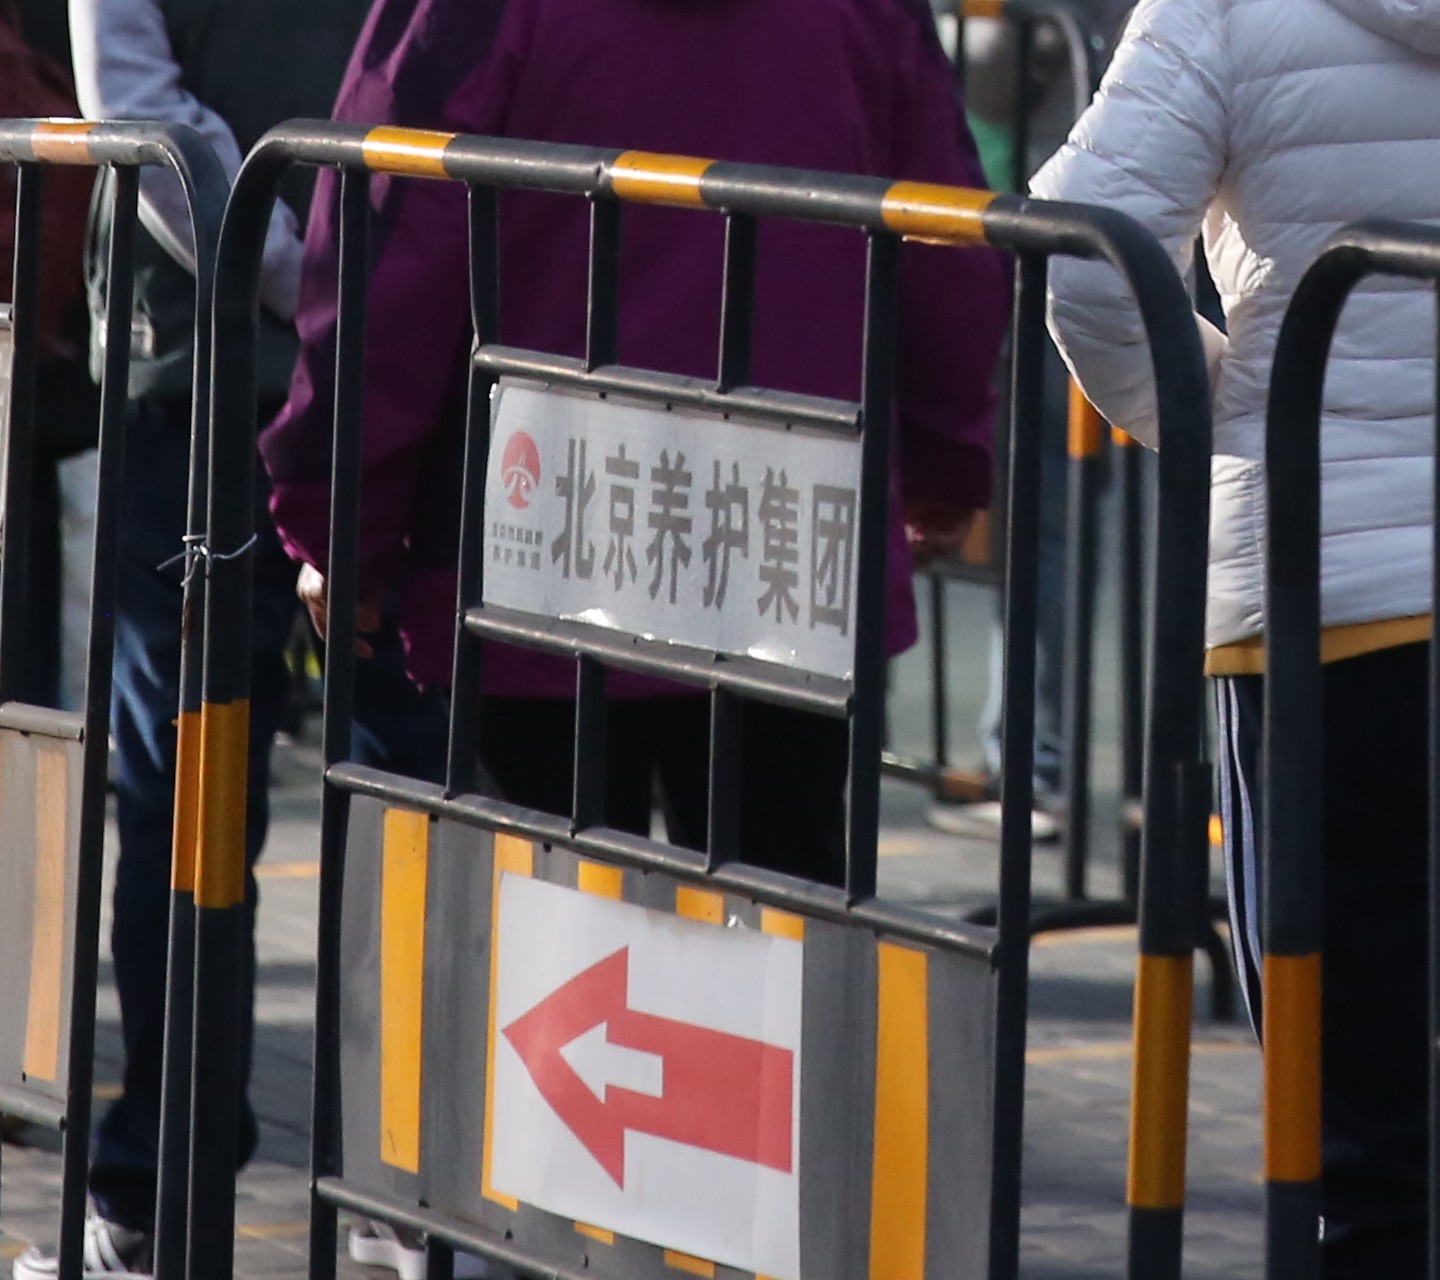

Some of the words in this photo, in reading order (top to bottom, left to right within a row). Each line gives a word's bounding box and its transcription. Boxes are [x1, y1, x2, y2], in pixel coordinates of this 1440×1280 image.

[551, 438, 857, 636] 北京养护集团
